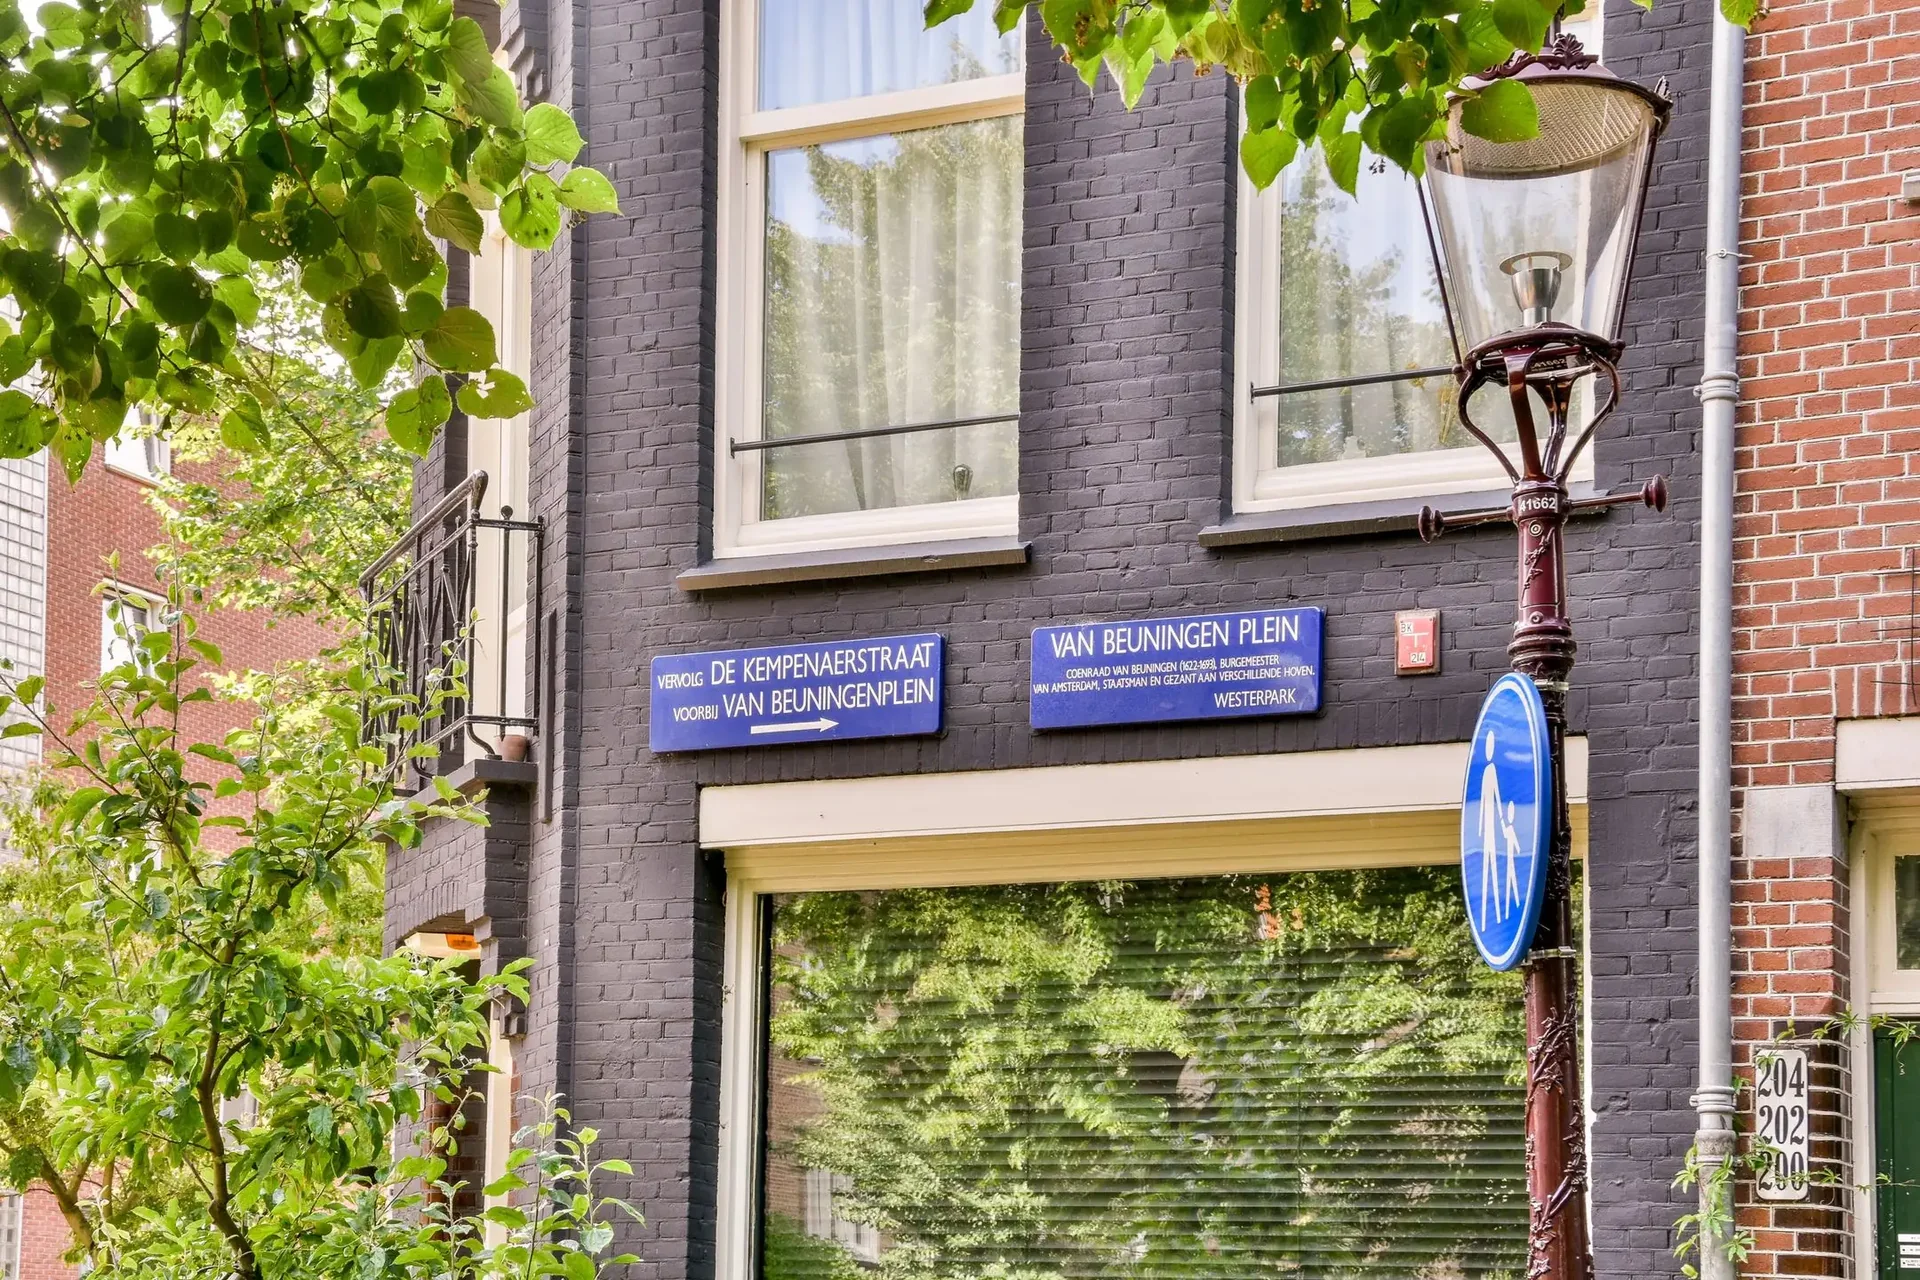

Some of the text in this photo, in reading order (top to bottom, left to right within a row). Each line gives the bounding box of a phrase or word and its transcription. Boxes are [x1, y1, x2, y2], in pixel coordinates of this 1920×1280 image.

[1520, 497, 1556, 512] 41662
[1051, 615, 1299, 658] VAN BEUNINGEN PLEIN
[657, 642, 935, 690] VERVOLG DE KEMPENAERSTRAAT
[1033, 665, 1316, 694] VAN AMSTERDAM, STAATSMAN EN GEZANT AAN VERSCHILLENDE HOVEN.
[1066, 666, 1111, 679] COENRAAD
[1112, 664, 1129, 676] VAN
[1131, 661, 1178, 675] BEUNINGEN
[1220, 654, 1280, 669] BURGEMEESTER
[673, 677, 934, 722] VOORBIJ VAN BEUNINGENPLEIN
[1214, 688, 1296, 708] WESTERPARK
[1758, 1057, 1805, 1098] 204
[1759, 1105, 1805, 1145] 202
[1758, 1151, 1805, 1191] 200
